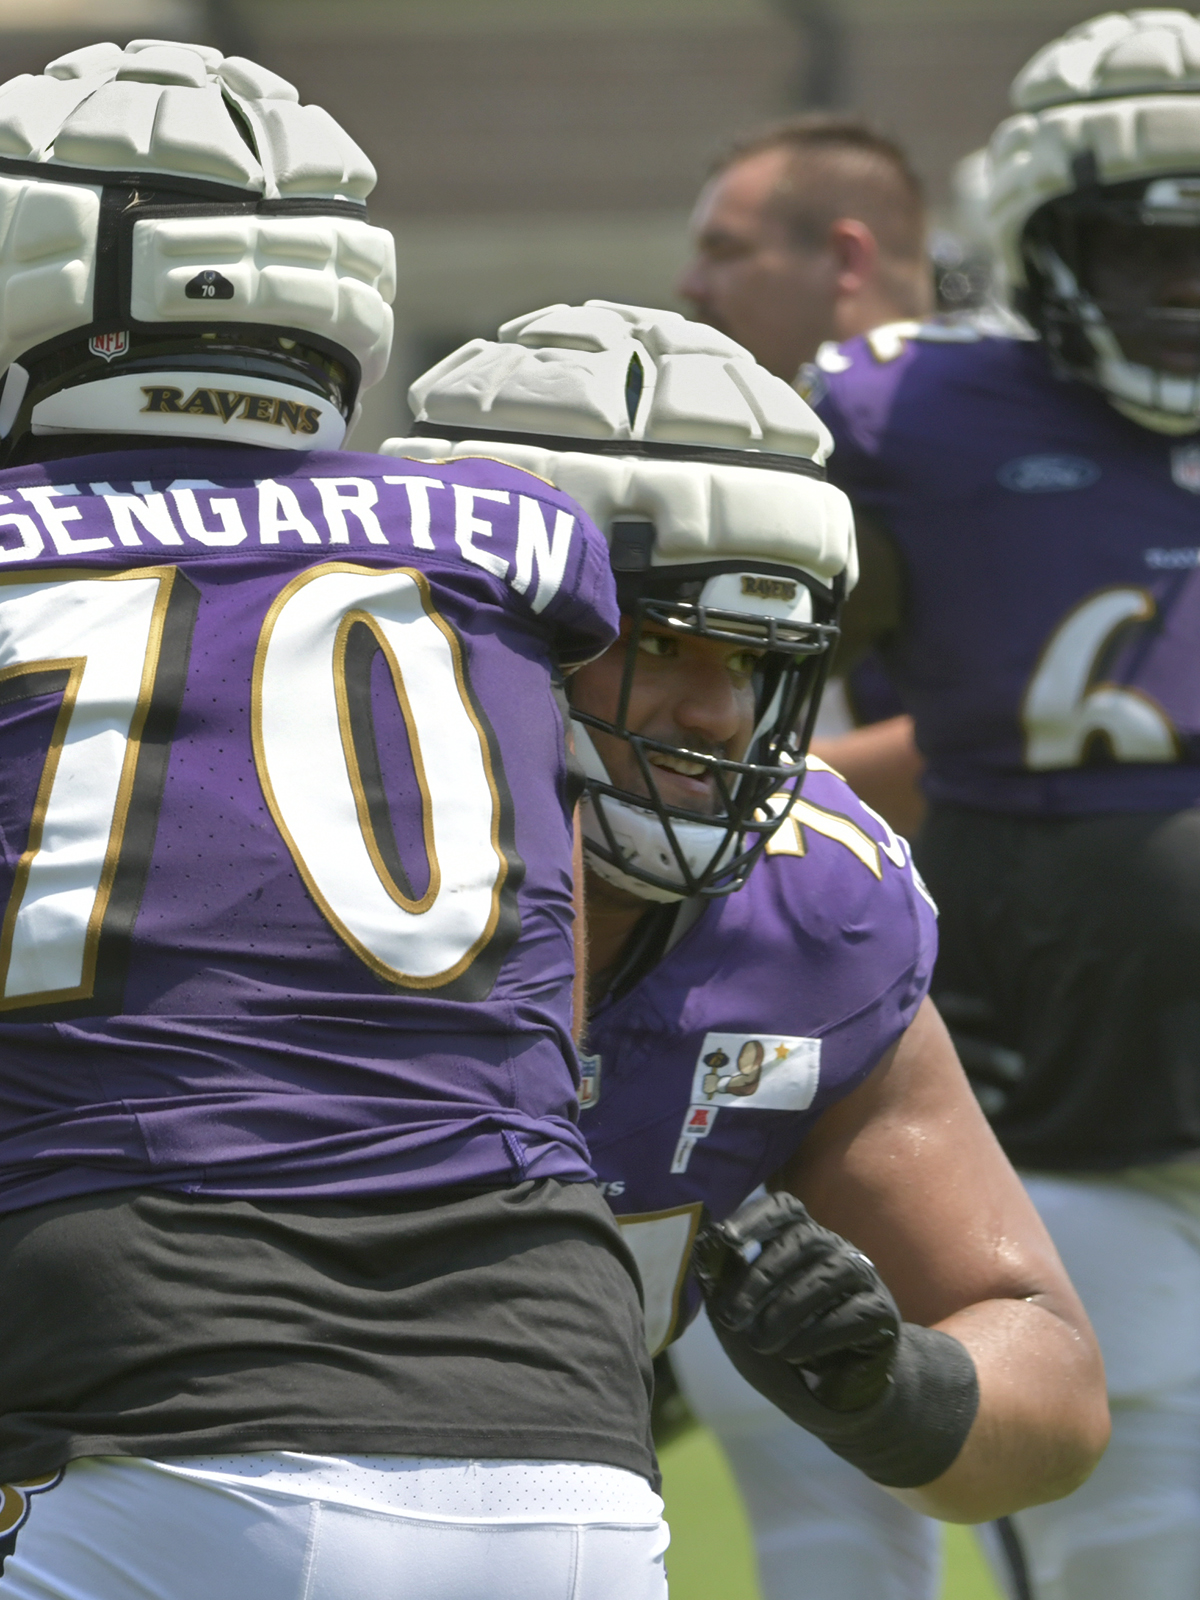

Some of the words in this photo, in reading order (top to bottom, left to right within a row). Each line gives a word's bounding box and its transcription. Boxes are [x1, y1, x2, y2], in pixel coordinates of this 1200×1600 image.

[201, 285, 216, 297] 70
[94, 331, 124, 353] NFL
[139, 385, 323, 434] RAVENS
